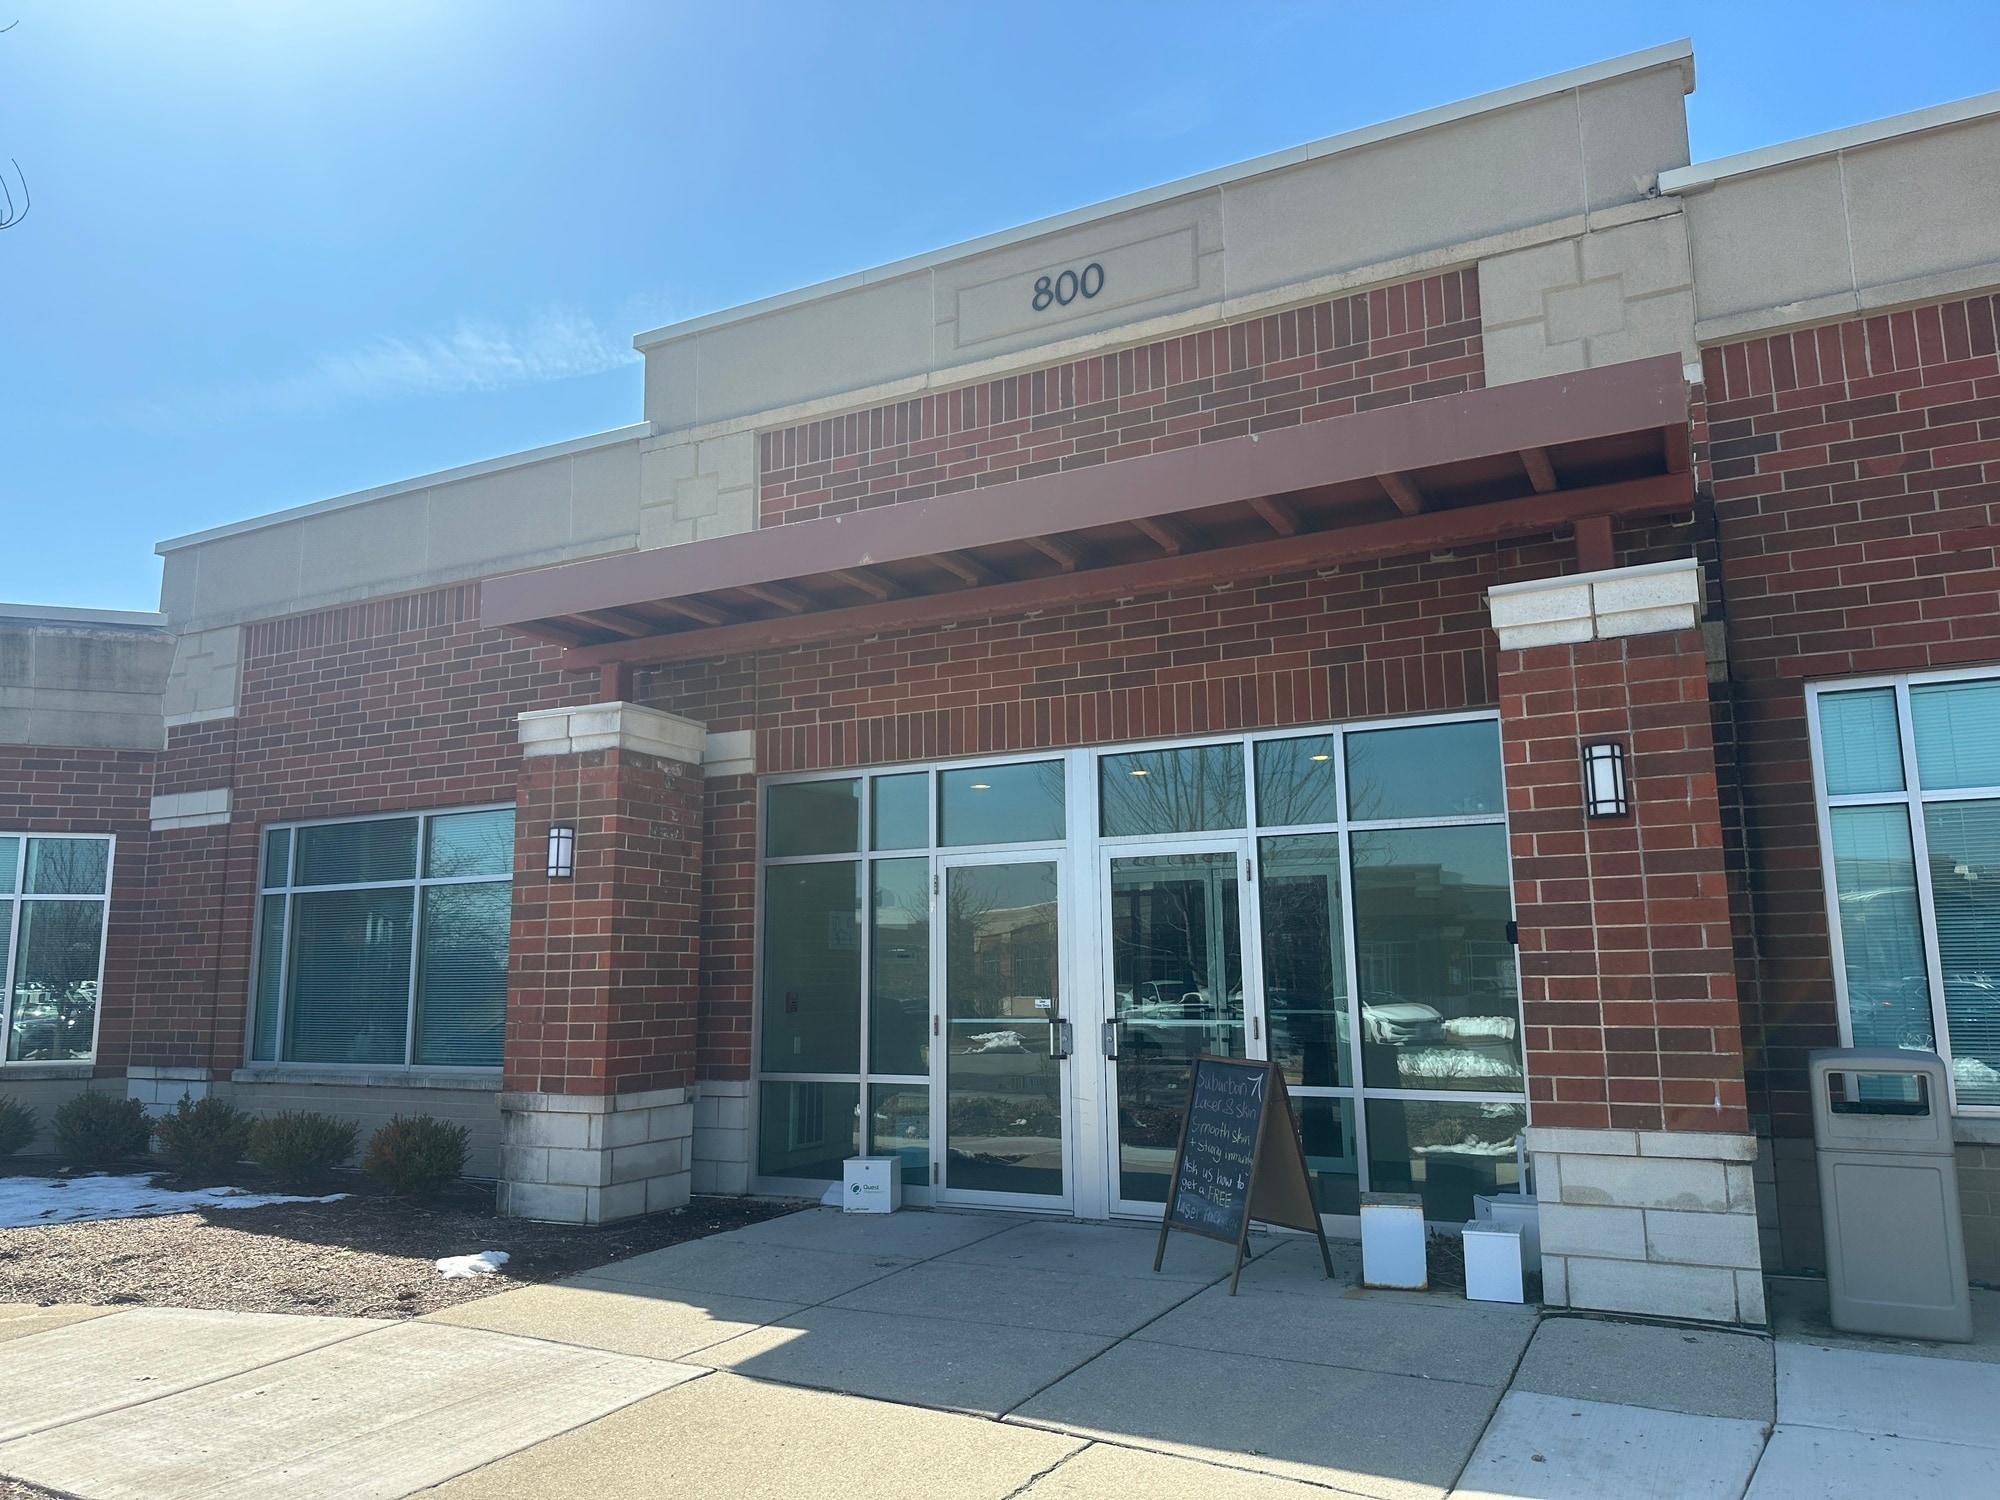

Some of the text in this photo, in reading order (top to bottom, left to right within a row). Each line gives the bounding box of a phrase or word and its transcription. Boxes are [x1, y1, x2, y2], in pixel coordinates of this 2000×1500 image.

[1032, 263, 1104, 311] 800
[1197, 1070, 1247, 1096] Suburban
[1194, 1092, 1222, 1112] Laser
[1191, 1116, 1230, 1141] Smooth
[1183, 1155, 1245, 1190] Ask us how to
[1180, 1178, 1232, 1208] get a FREE
